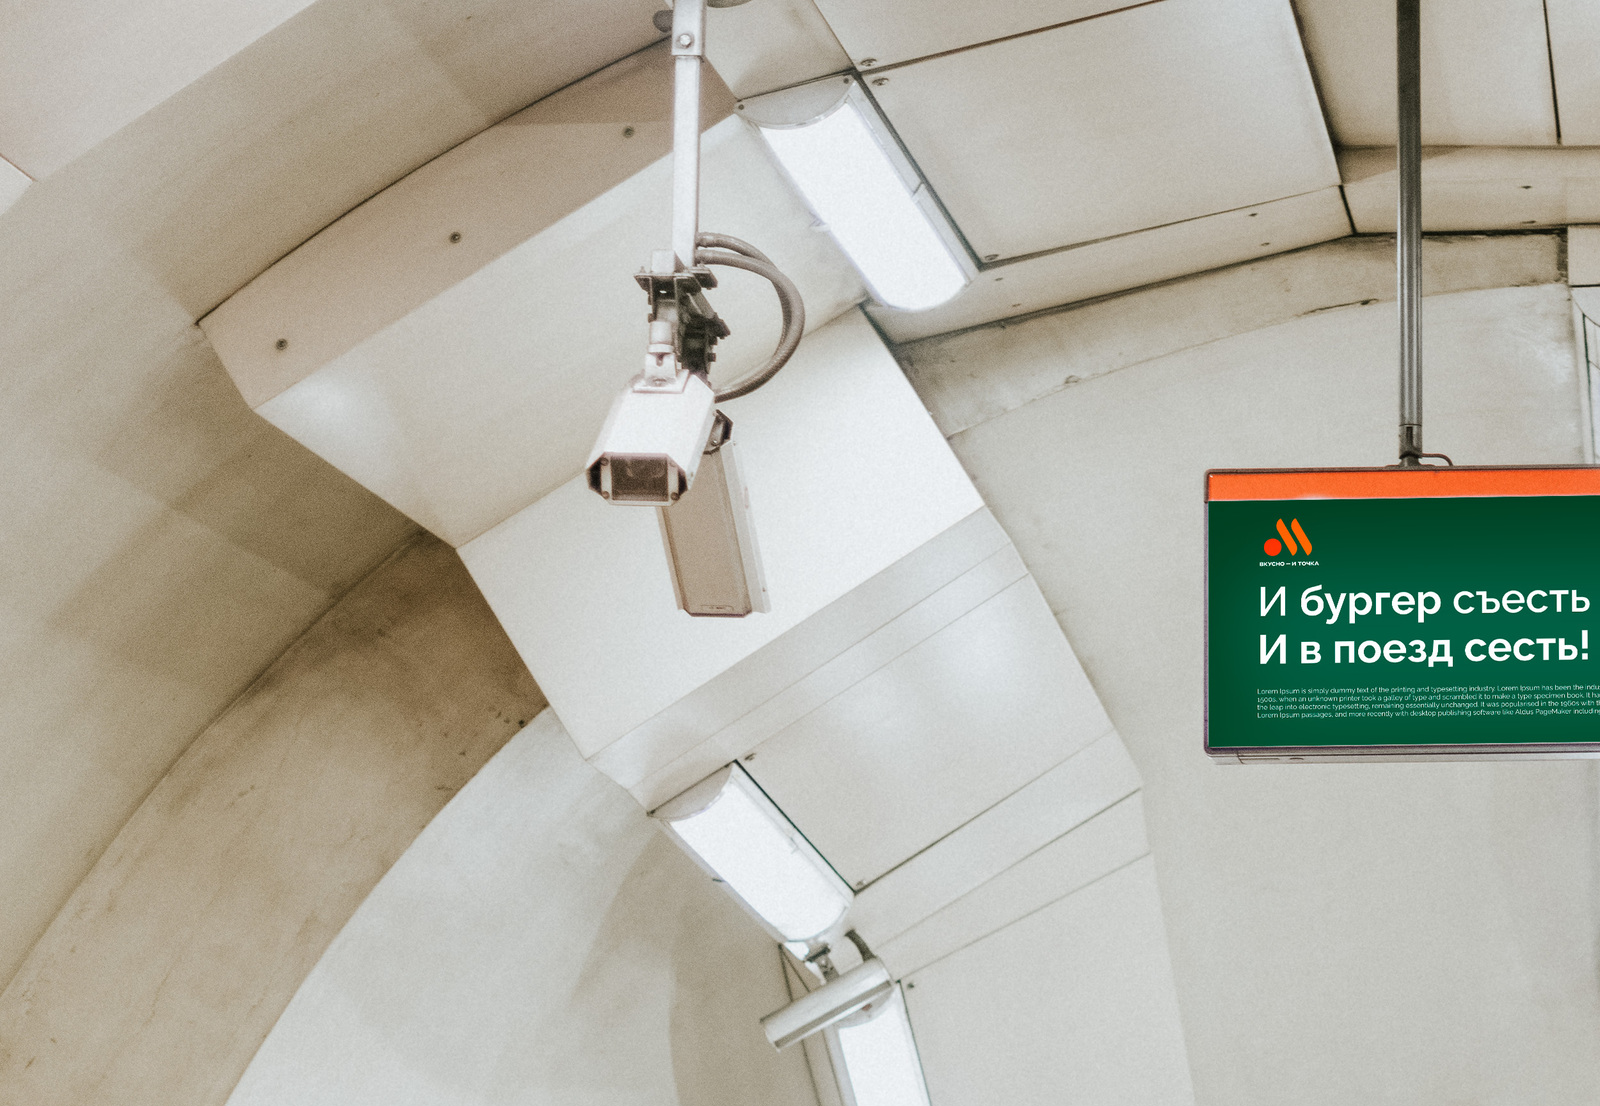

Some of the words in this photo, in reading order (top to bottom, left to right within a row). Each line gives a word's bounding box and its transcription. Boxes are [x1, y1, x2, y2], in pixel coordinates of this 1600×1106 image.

[1260, 587, 1286, 616] И
[1301, 585, 1441, 624] бургер
[1453, 589, 1591, 614] съесть
[1260, 634, 1286, 664] И
[1301, 641, 1320, 664] в
[1334, 640, 1453, 667] поезд
[1465, 630, 1589, 661] сесть!
[1280, 688, 1300, 696] Ipsum
[1330, 687, 1356, 695] dummy
[1430, 686, 1468, 694] typesetting
[1520, 685, 1540, 693] Ipsum
[1383, 694, 1403, 702] galley
[1412, 694, 1427, 702] type
[1533, 692, 1566, 700] specimen
[1372, 702, 1404, 710] remaining
[1405, 702, 1440, 710] essentially
[1366, 710, 1394, 718] recently
[1535, 708, 1572, 716] PageMaker
